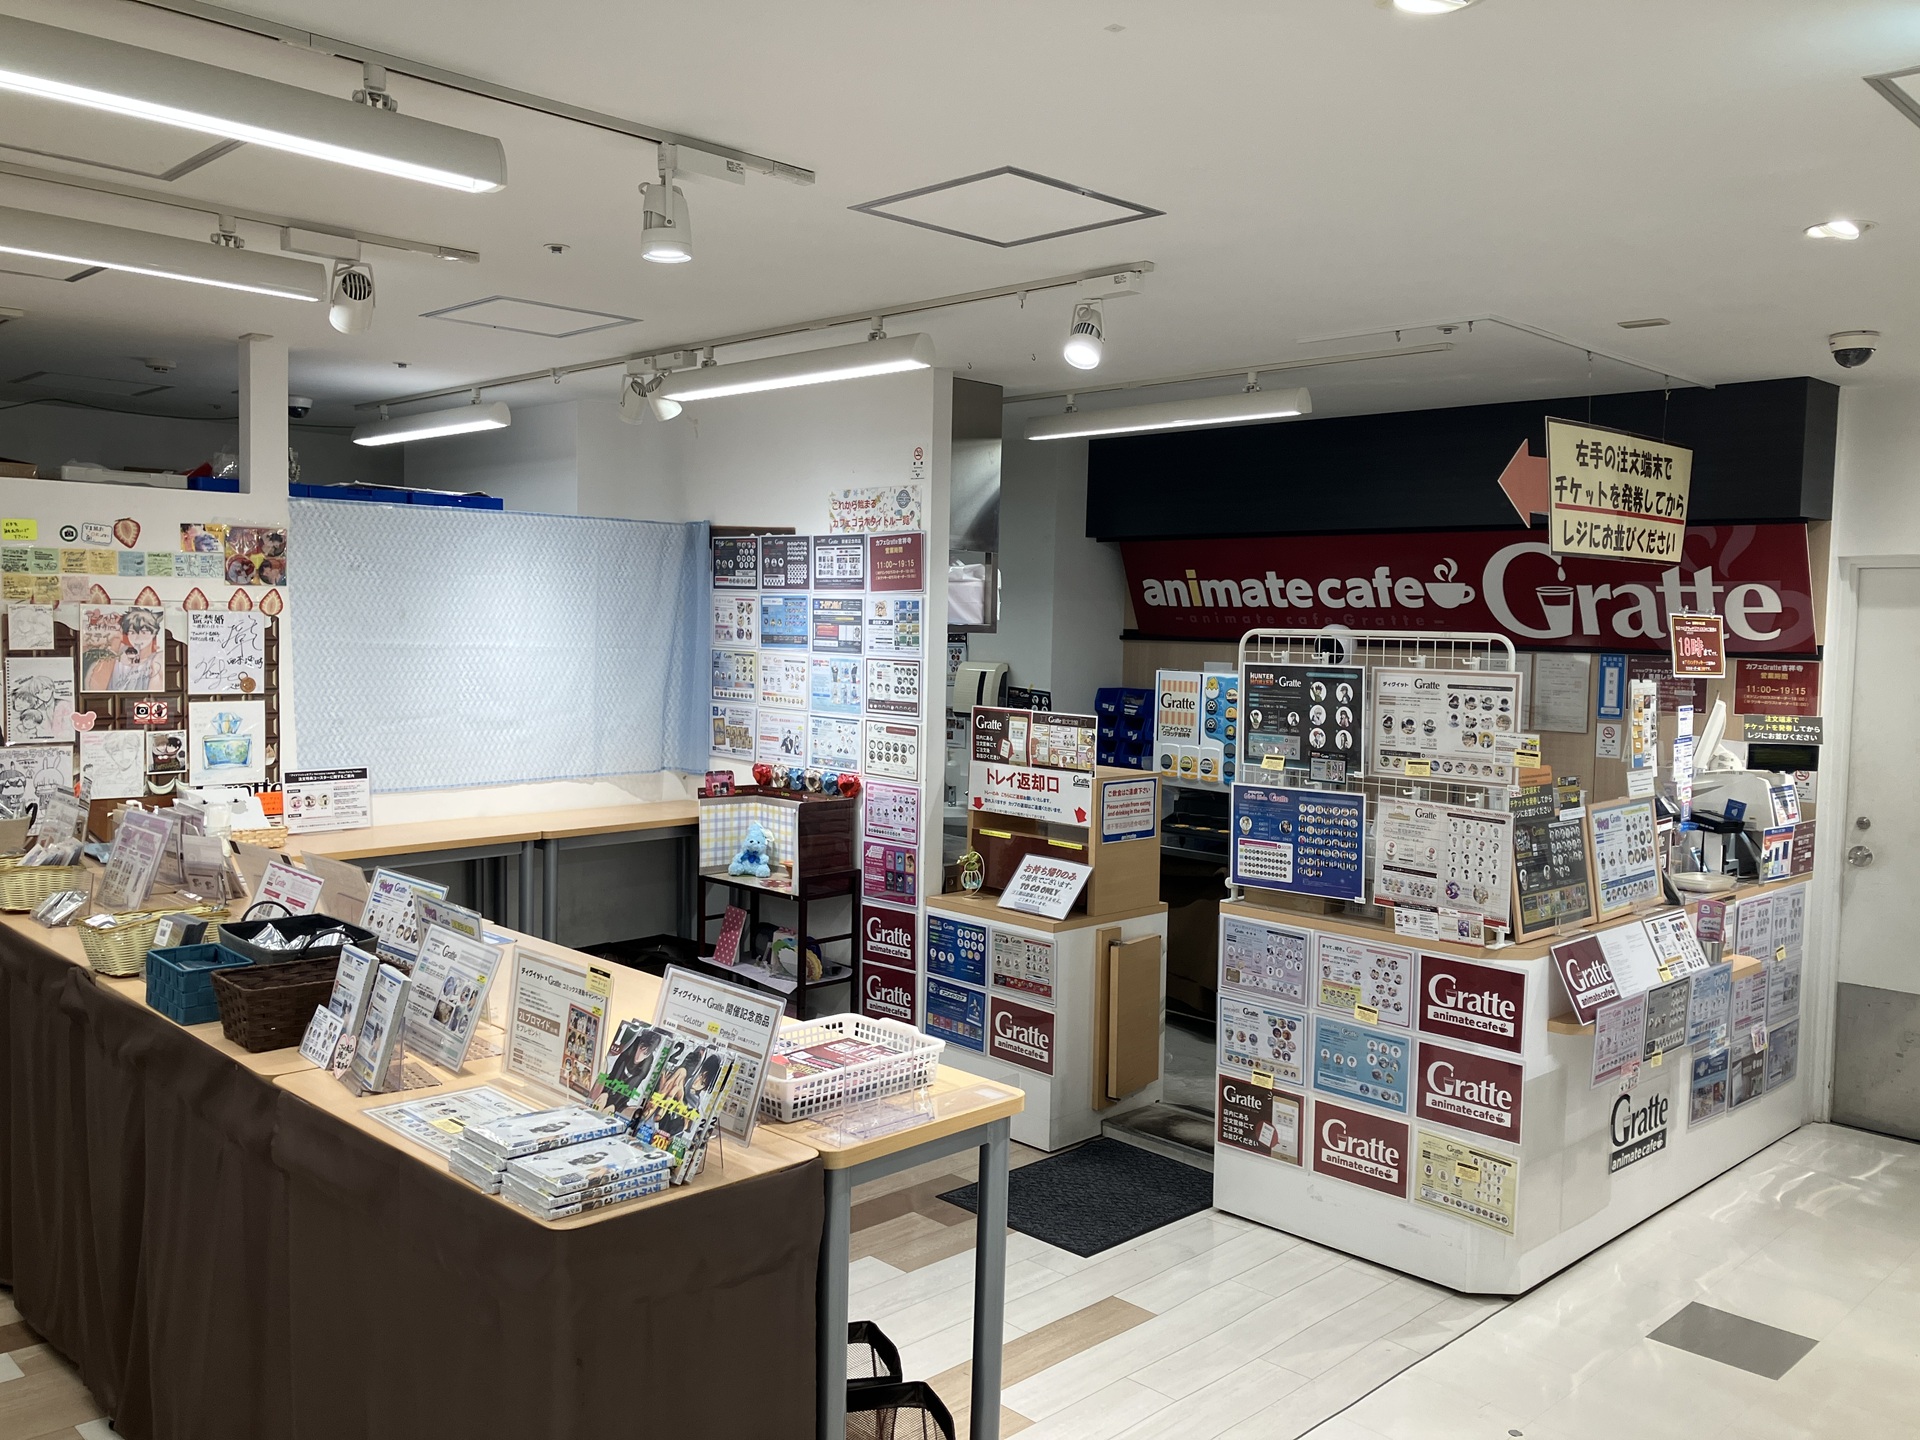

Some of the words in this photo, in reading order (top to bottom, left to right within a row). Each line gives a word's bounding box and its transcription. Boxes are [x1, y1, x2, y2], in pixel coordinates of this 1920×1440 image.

[1576, 439, 1672, 480] 左手の注文端末で
[832, 500, 877, 510] これから始まる
[1555, 475, 1684, 518] チケットを発券してから
[1563, 520, 1675, 555] レジにお並びください
[1142, 569, 1313, 608] animate
[1318, 566, 1425, 608] cafe
[1482, 541, 1782, 641] Gratte
[1746, 664, 1803, 672] カフェGratte吉祥寺
[1761, 672, 1788, 680] 営業時間
[1279, 676, 1301, 687] Gratte
[1414, 678, 1440, 689] Gratte
[1746, 685, 1806, 695] 11:00～19:15
[1161, 693, 1195, 709] Gratte
[975, 715, 1002, 730] Gratte
[1744, 724, 1820, 733] チケットを発券してから
[1765, 715, 1799, 723] 注文端末で
[1748, 732, 1818, 741] レジにお並びください
[987, 768, 1059, 793] トレイ返却口
[1415, 808, 1437, 820] Gratte
[1024, 864, 1077, 881] お持ち帰りのみ
[1020, 875, 1072, 890] の提供でございます。
[1041, 887, 1060, 896] ONLY
[867, 917, 911, 947] Gratte
[869, 944, 891, 954] animate
[891, 947, 904, 957] cafe
[521, 967, 545, 981] ディグイット
[1566, 958, 1613, 992] Gratte
[867, 975, 911, 1007] Gratte
[1428, 973, 1516, 1020] Gratte
[1581, 991, 1600, 1006] animate
[1600, 987, 1614, 999] cafe
[673, 987, 701, 1002] ディグイット
[706, 997, 724, 1012] Gratte
[725, 1003, 770, 1027] 開催記念商品
[869, 1002, 891, 1012] animate
[891, 1005, 903, 1015] cafe
[995, 1011, 1049, 1049] Gratte
[1433, 1010, 1475, 1027] animate
[1476, 1017, 1498, 1032] cafe
[668, 1041, 685, 1064] 2
[998, 1040, 1024, 1055] animate
[1024, 1046, 1038, 1058] cafe
[1427, 1061, 1512, 1110] Gratte
[1223, 1085, 1262, 1109] Gratte
[1223, 1109, 1249, 1121] 店内にある
[1431, 1097, 1472, 1113] animate
[1473, 1107, 1495, 1122] cafe
[1611, 1093, 1668, 1147] Gratte
[1223, 1133, 1259, 1147] お並びください
[1322, 1119, 1399, 1167] Gratte
[1612, 1147, 1641, 1171] animate
[1641, 1139, 1658, 1156] cafe
[1326, 1154, 1363, 1171] animate
[1364, 1166, 1384, 1178] cafe
